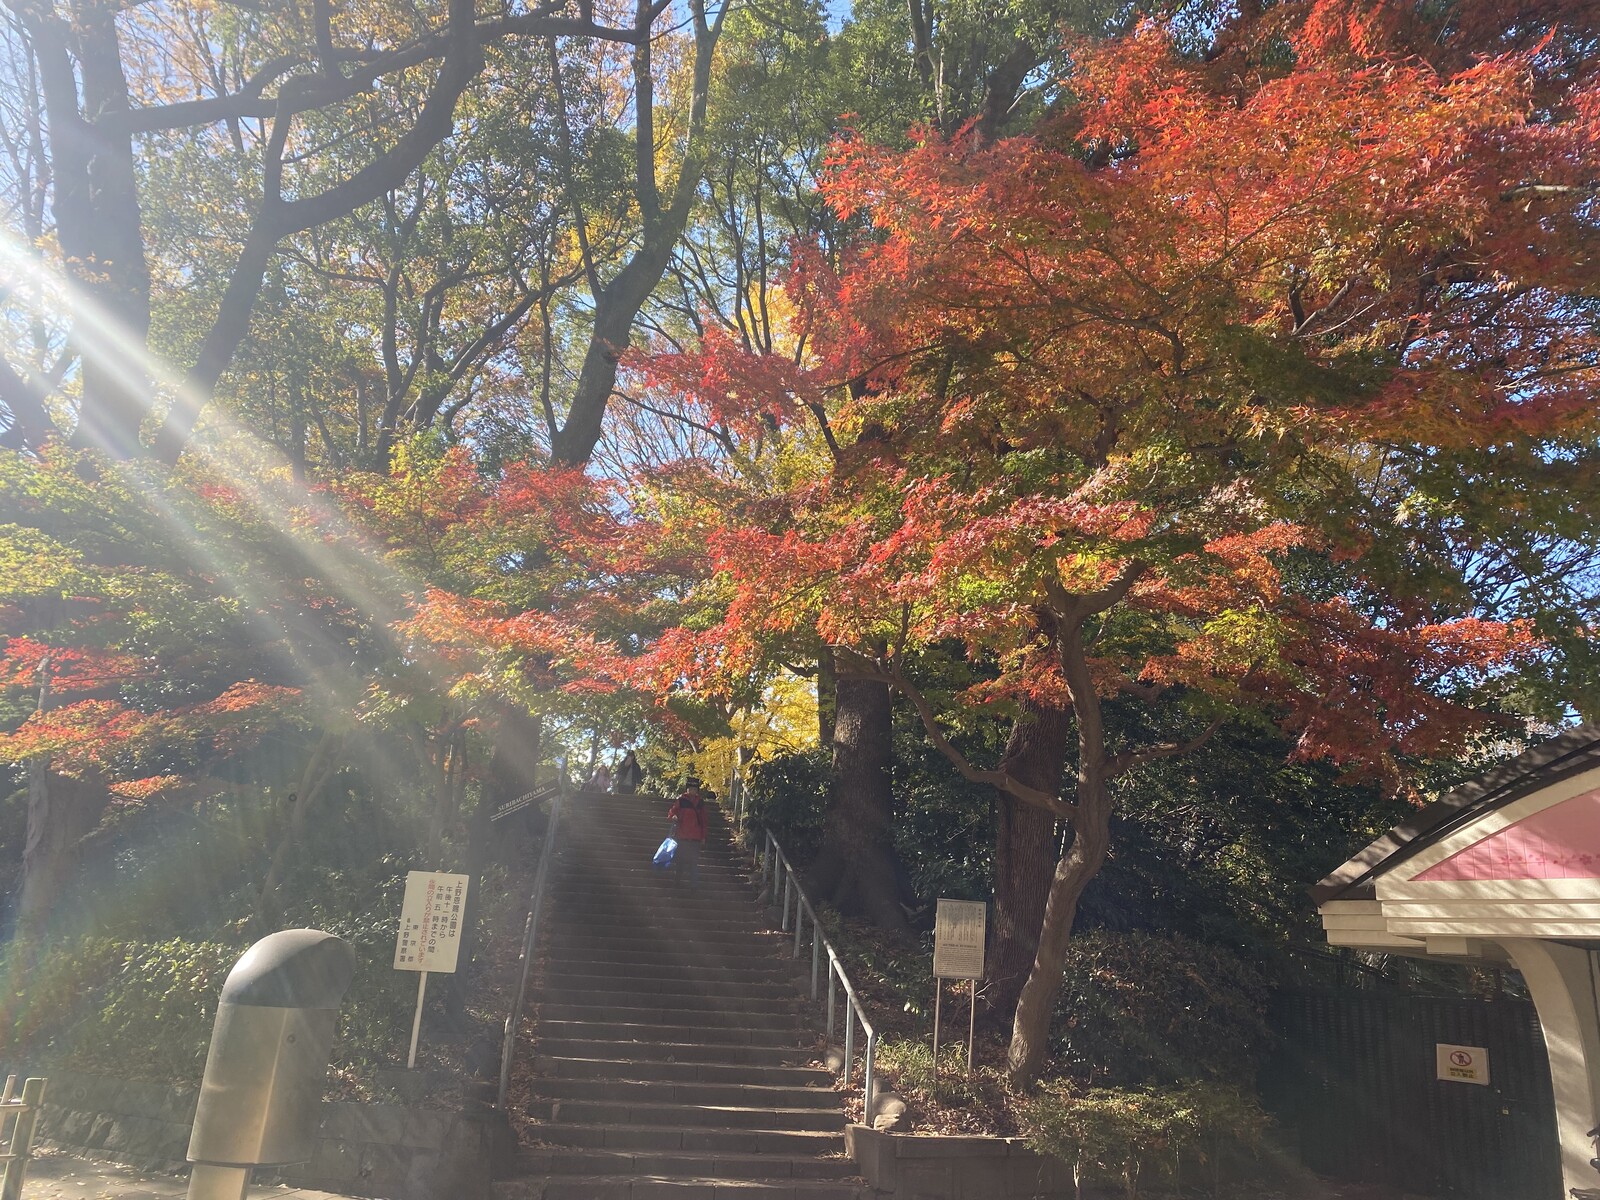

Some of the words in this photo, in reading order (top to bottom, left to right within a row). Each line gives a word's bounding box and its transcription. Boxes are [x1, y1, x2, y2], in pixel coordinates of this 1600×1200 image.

[498, 786, 546, 811] SURIBACHIYAMA
[439, 886, 453, 938] 午後十一時から
[448, 880, 463, 938] 上野恩賜公園は
